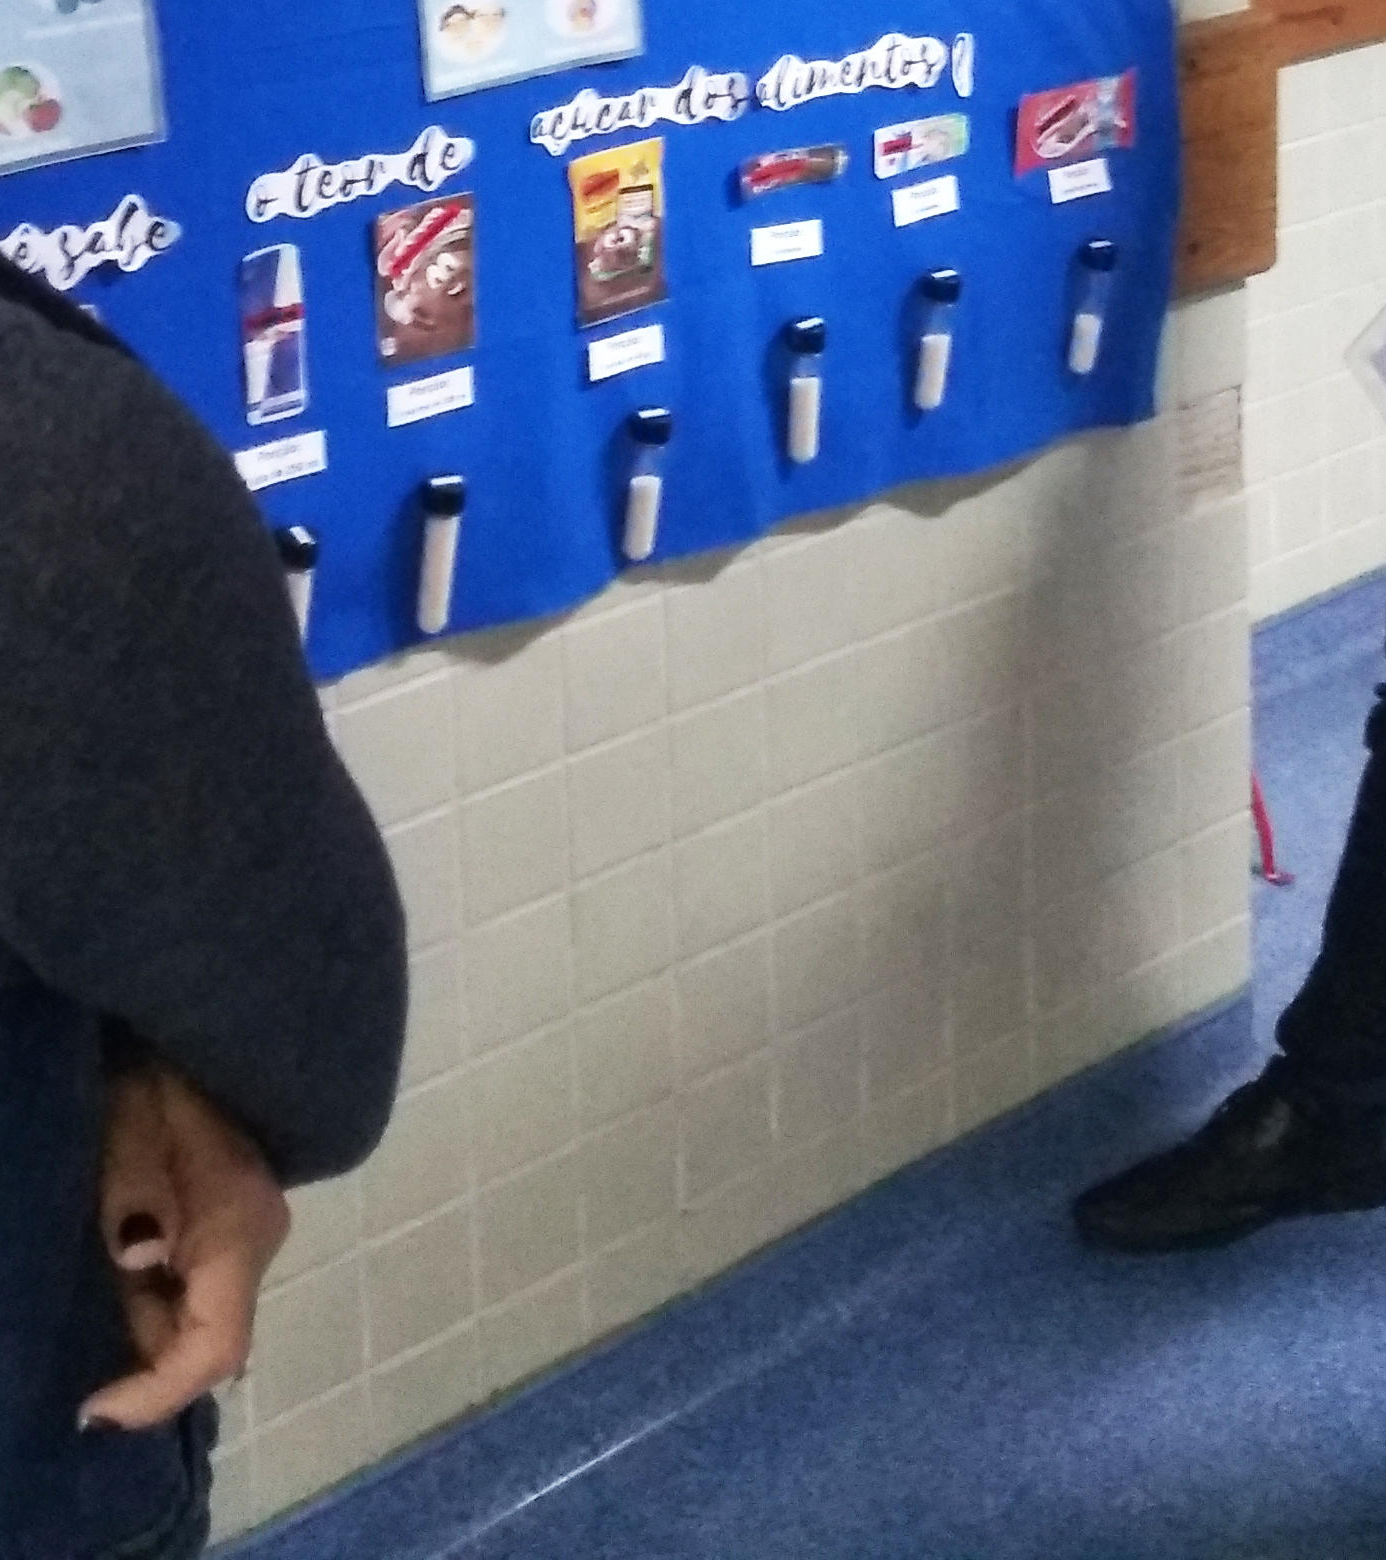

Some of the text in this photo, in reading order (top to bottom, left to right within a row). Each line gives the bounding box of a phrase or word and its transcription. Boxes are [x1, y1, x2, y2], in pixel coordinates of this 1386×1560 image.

[293, 154, 386, 213] teor
[408, 129, 462, 188] de
[674, 68, 749, 120] dos
